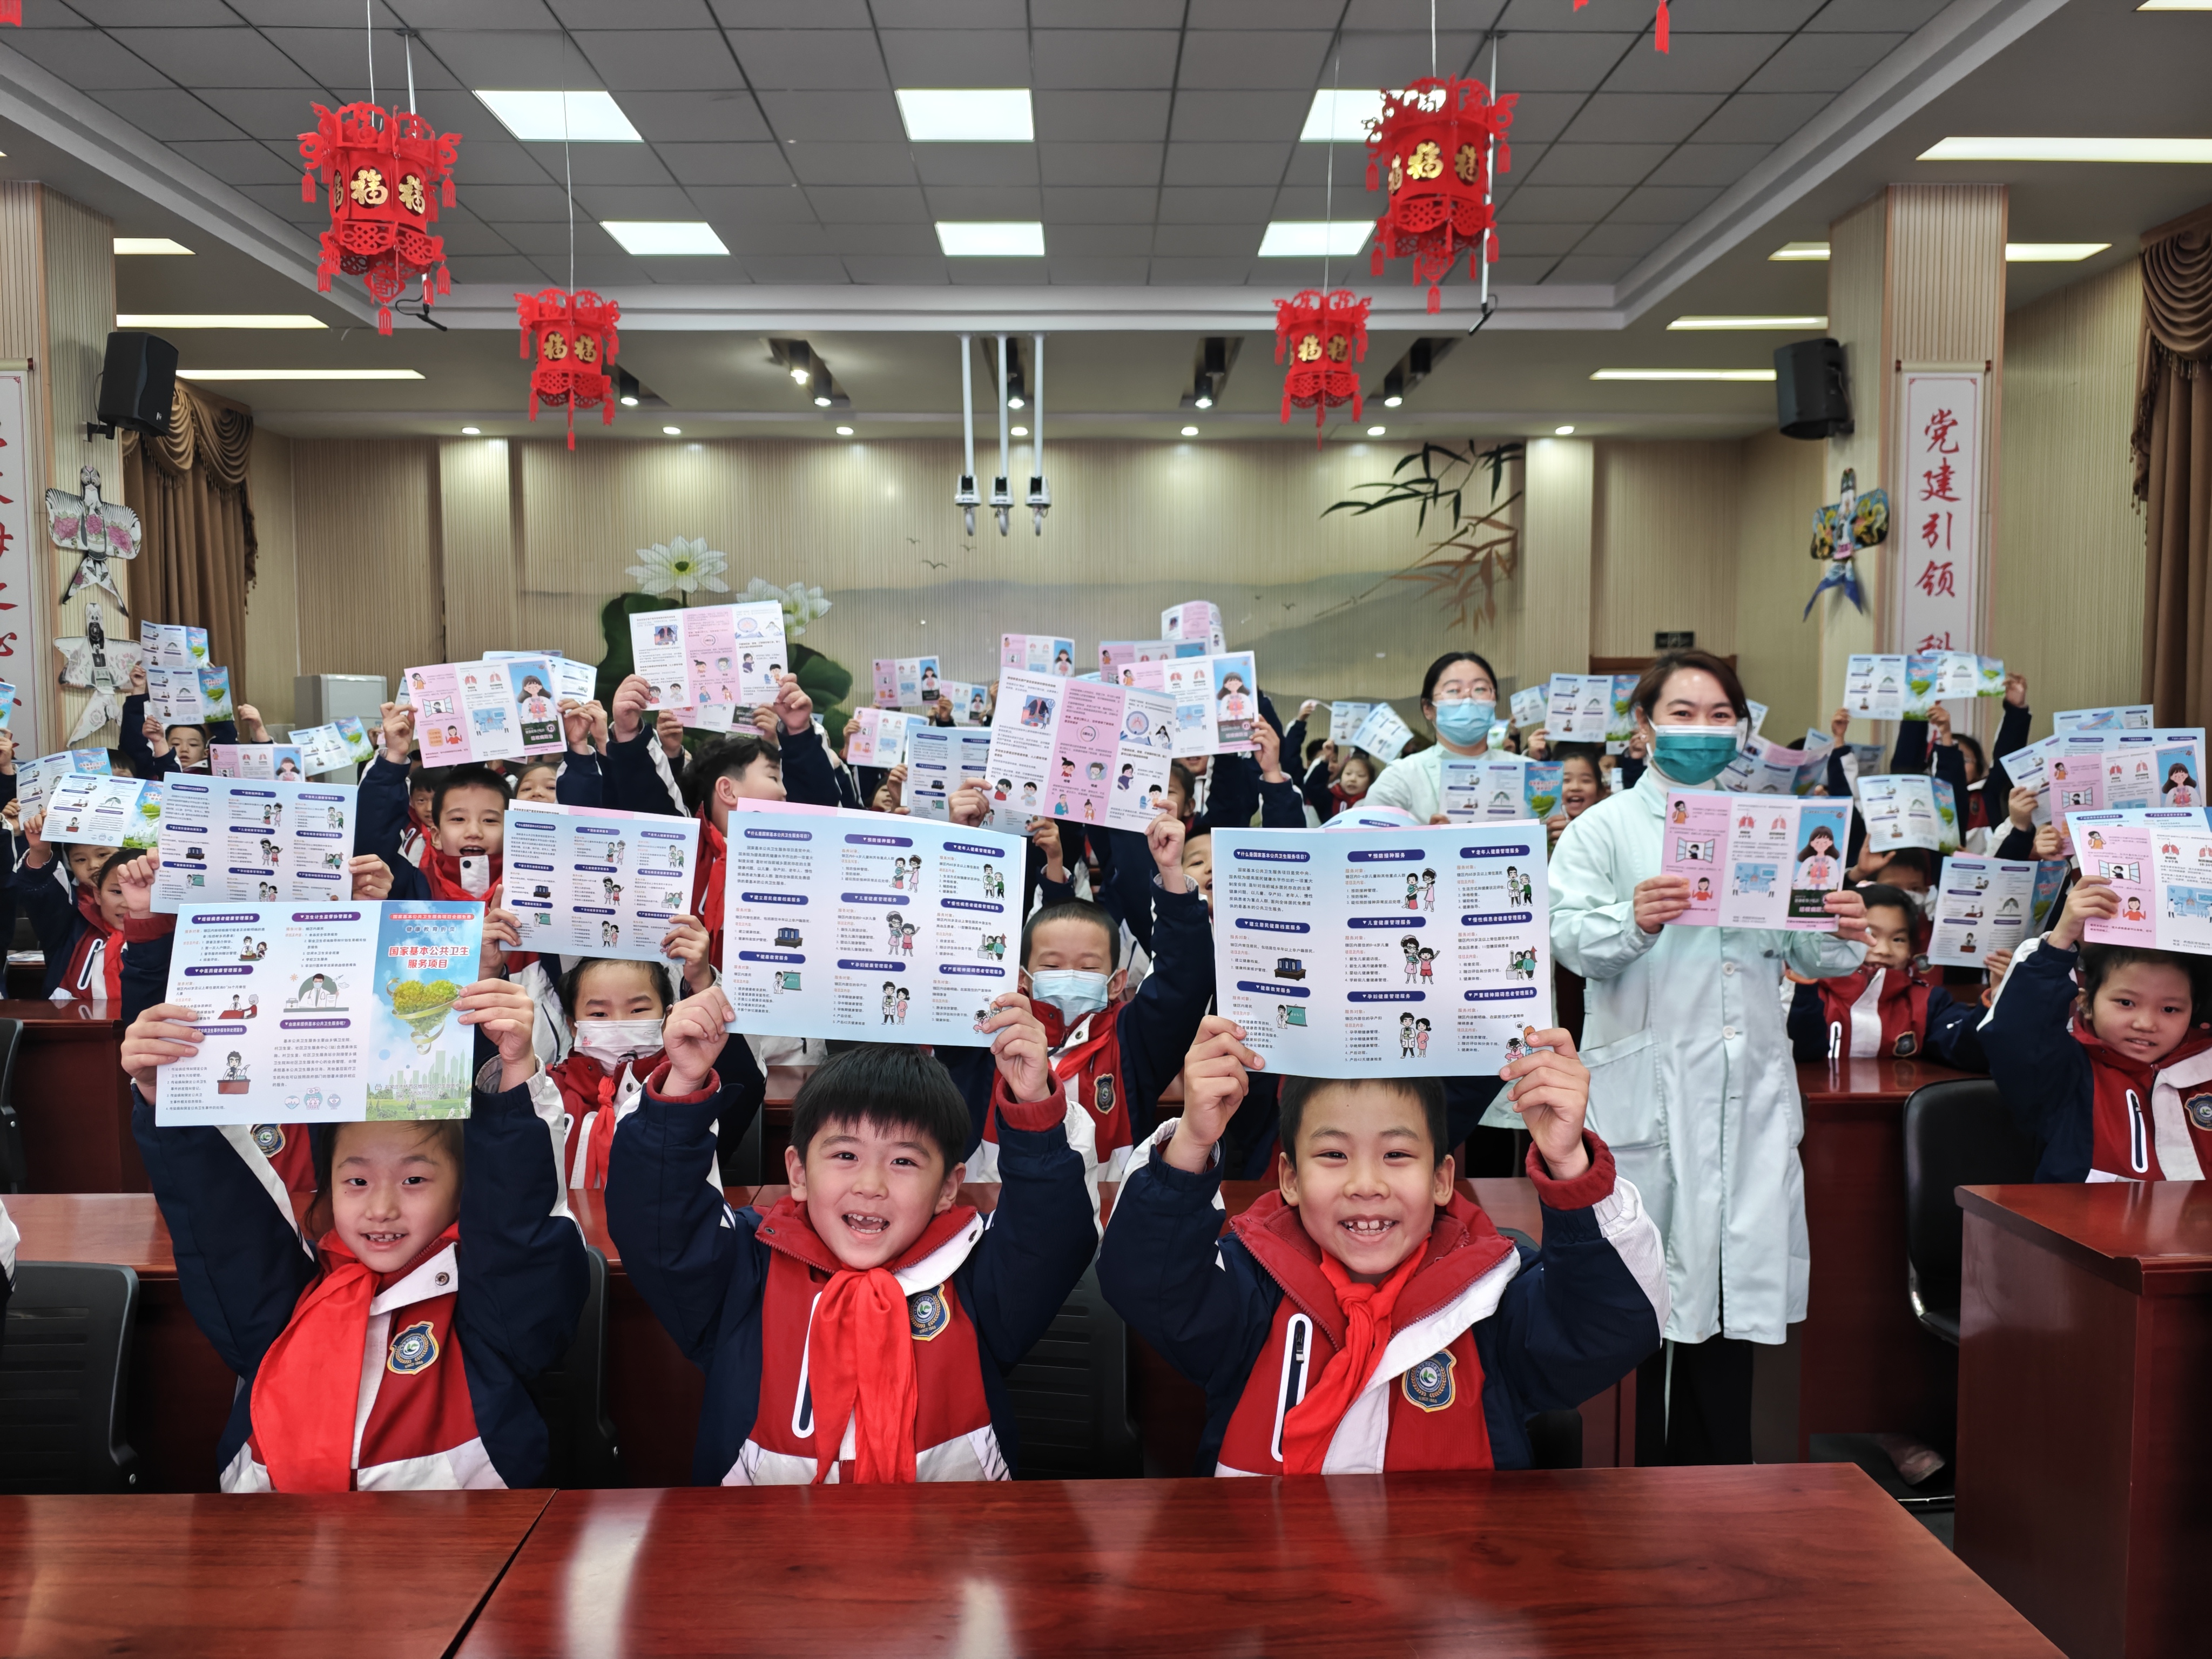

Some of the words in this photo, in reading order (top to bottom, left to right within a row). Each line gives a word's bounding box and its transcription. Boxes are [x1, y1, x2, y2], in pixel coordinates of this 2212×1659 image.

[1407, 141, 1444, 179] 福
[351, 169, 388, 205] 福
[399, 175, 426, 214] 福
[544, 333, 568, 359] 福
[575, 335, 597, 362] 福
[958, 846, 995, 854] 老年人健康管理服务
[1250, 921, 1300, 930] 建立居民健康档案服务
[389, 947, 469, 956] 国家基本公共卫生
[408, 960, 447, 968] 服务项目
[1261, 986, 1290, 994] 健康教育服务
